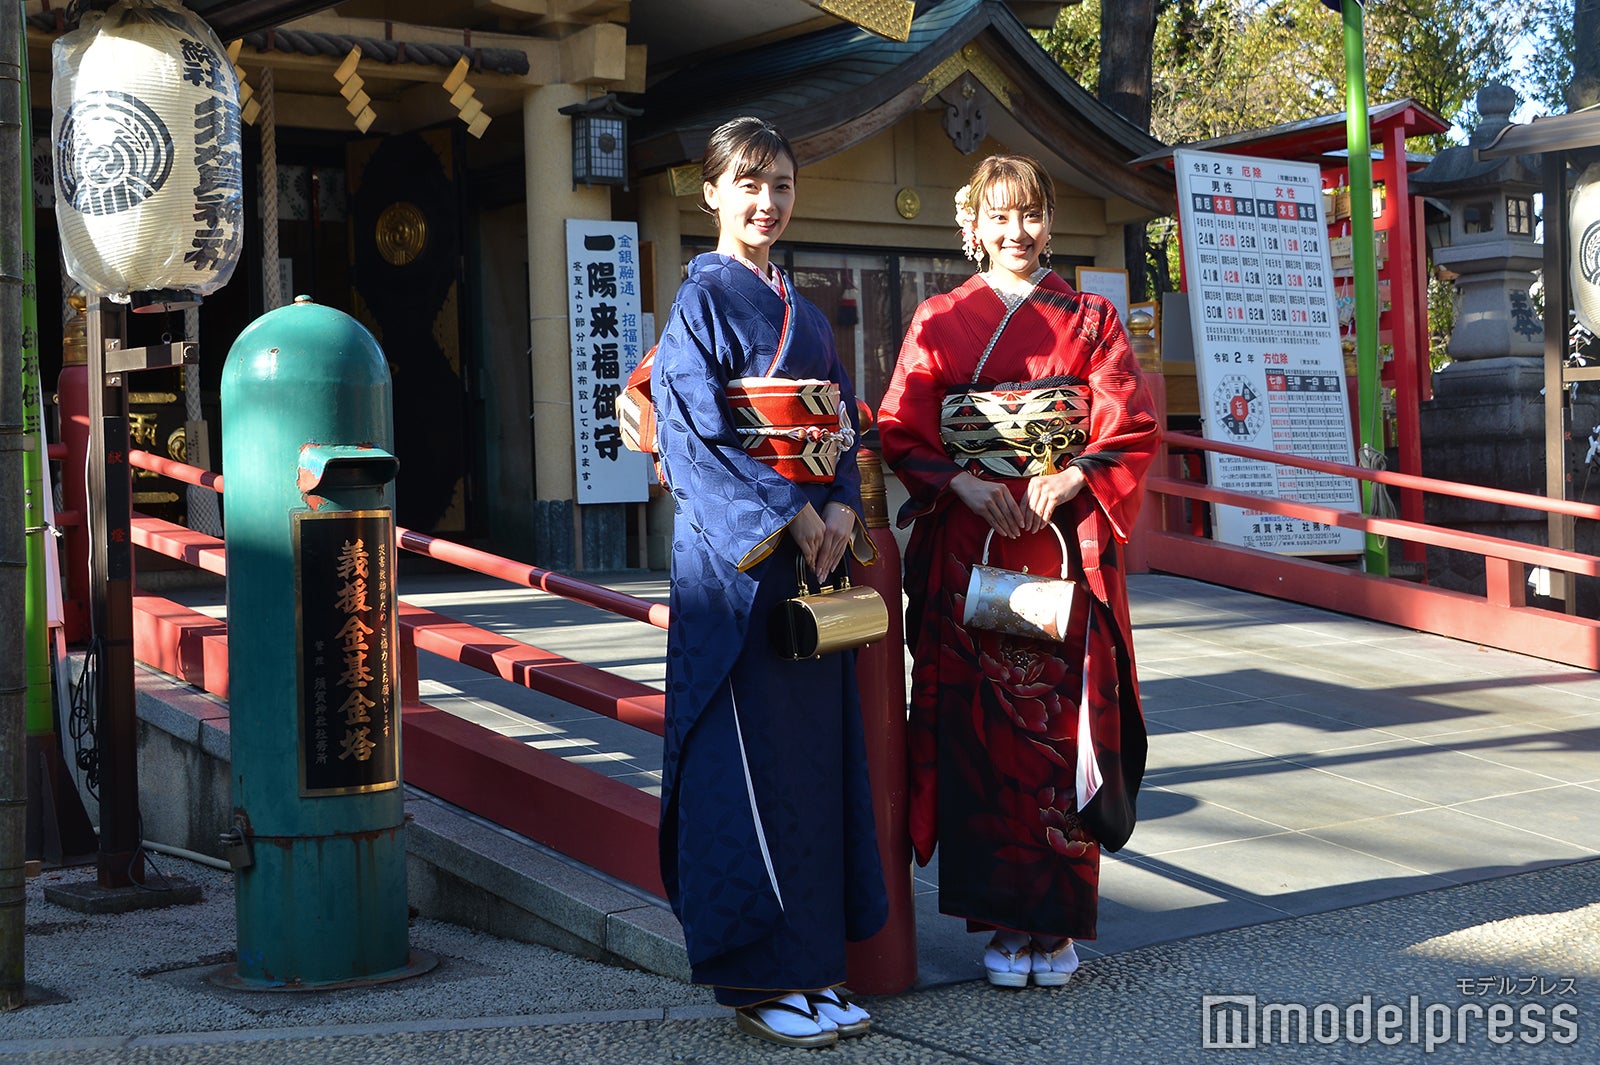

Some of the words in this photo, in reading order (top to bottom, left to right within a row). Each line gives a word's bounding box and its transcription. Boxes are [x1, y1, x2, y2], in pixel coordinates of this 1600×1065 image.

[1211, 180, 1232, 193] 男性
[1274, 186, 1295, 199] 女性
[1262, 352, 1288, 364] 方位除
[334, 538, 377, 761] 義援金基金塔
